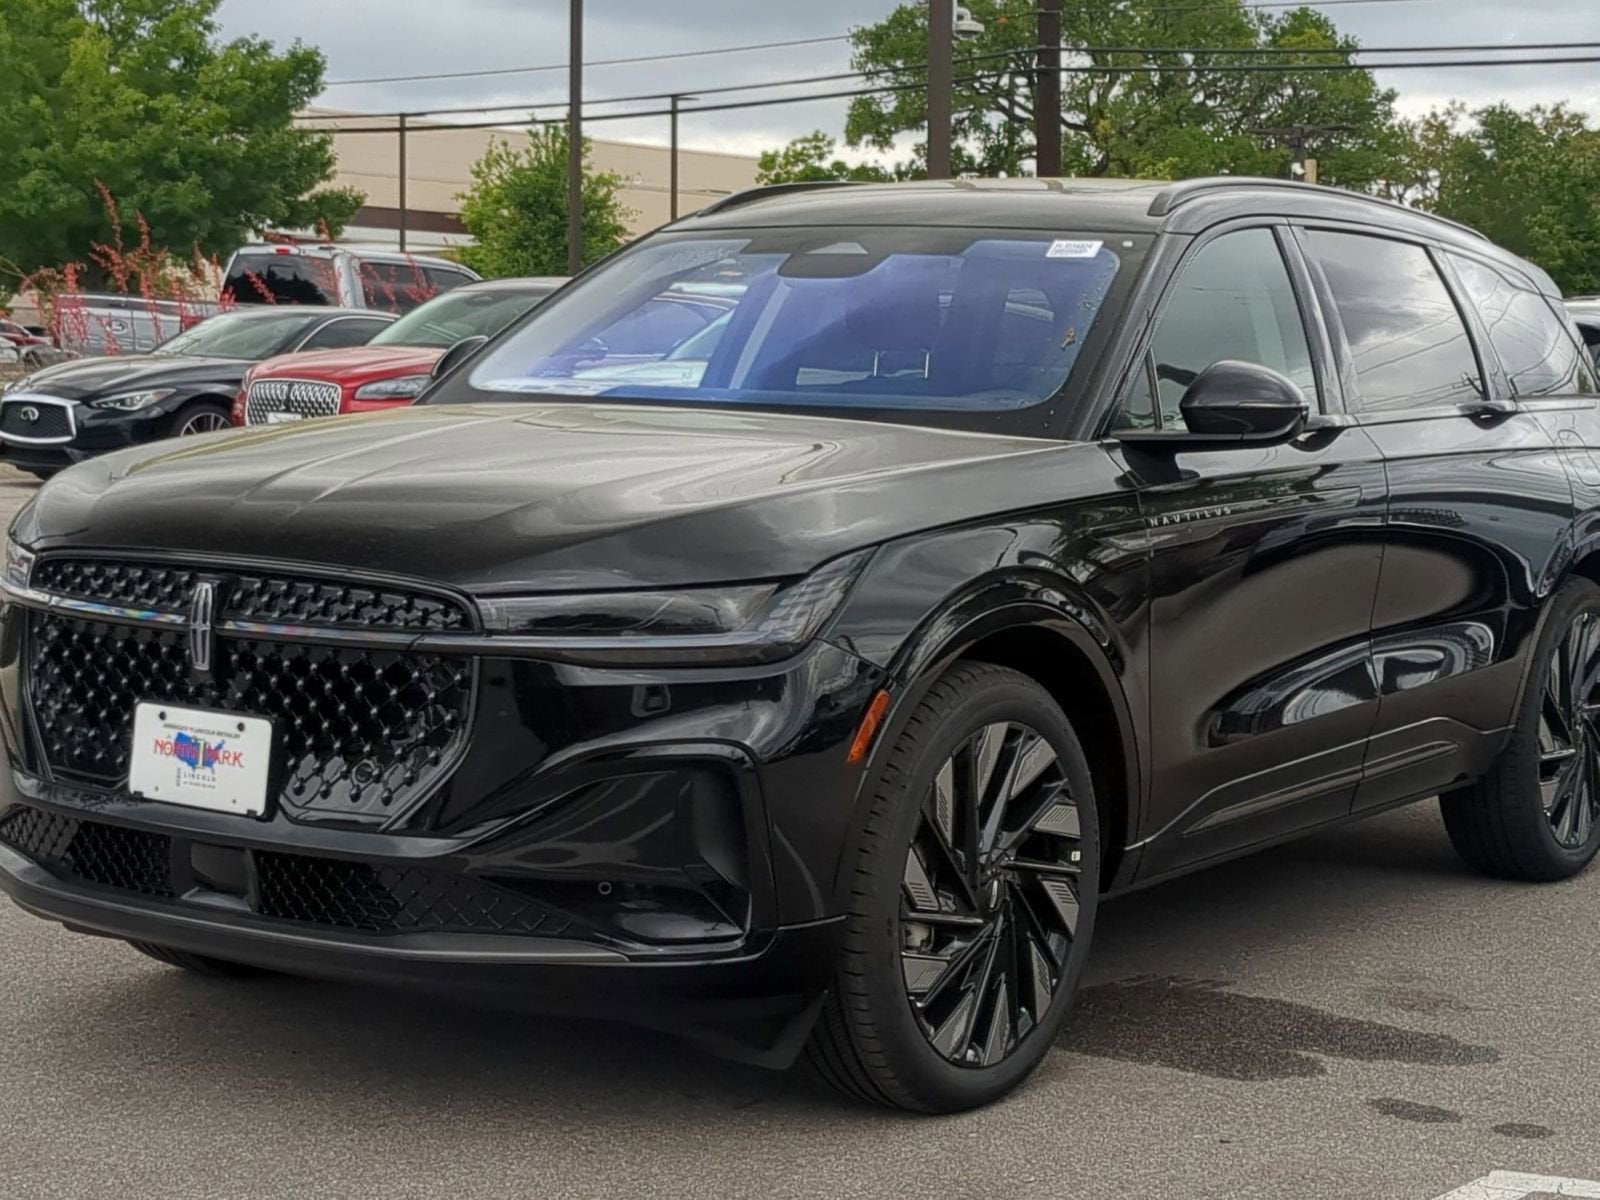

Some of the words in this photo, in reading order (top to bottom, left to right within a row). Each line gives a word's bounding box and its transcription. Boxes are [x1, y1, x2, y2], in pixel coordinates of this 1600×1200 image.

[1150, 506, 1231, 527] NAUTILUS
[153, 738, 198, 760] NORTH
[204, 742, 245, 769] PARK
[183, 771, 216, 782] LINCOLN
